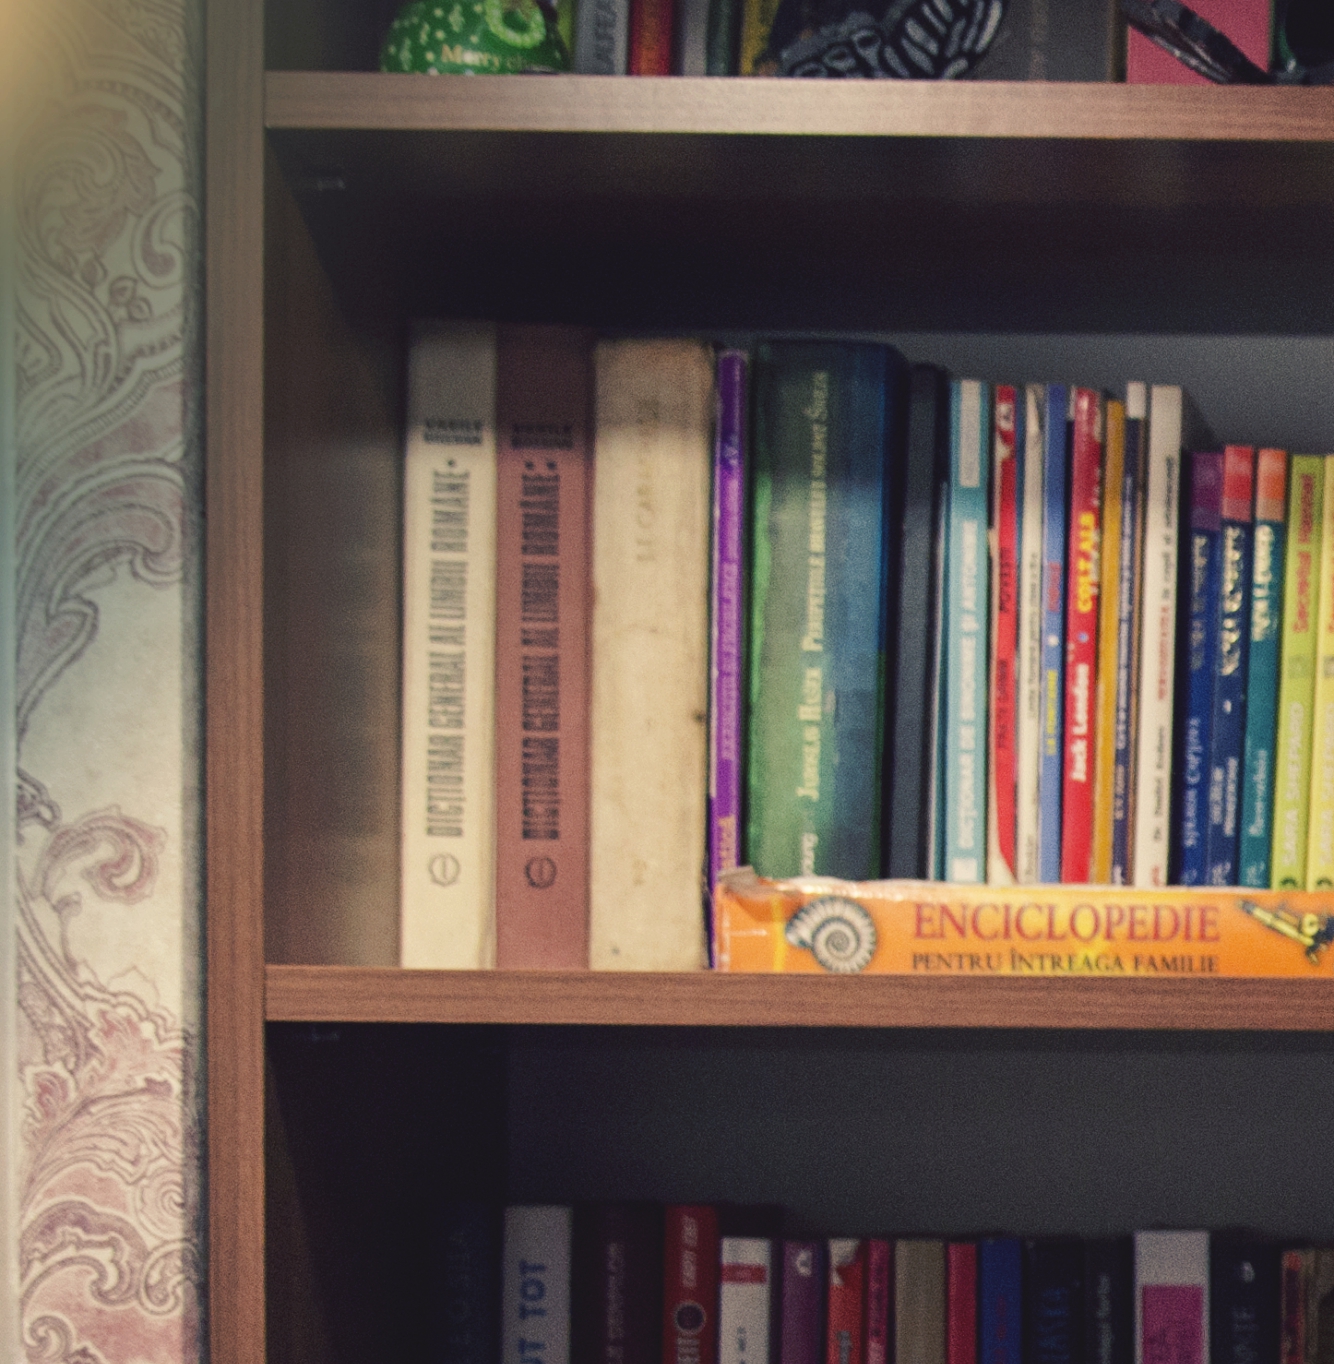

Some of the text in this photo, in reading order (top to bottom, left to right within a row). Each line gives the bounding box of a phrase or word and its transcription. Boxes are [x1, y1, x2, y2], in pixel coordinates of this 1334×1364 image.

[1070, 662, 1090, 735] London
[1069, 739, 1088, 782] Jack
[912, 901, 1221, 944] ENCICLOPEDIE
[911, 947, 1221, 975] PENTRU ÎNTREAGA FAMILIE
[519, 1259, 548, 1321] TOT
